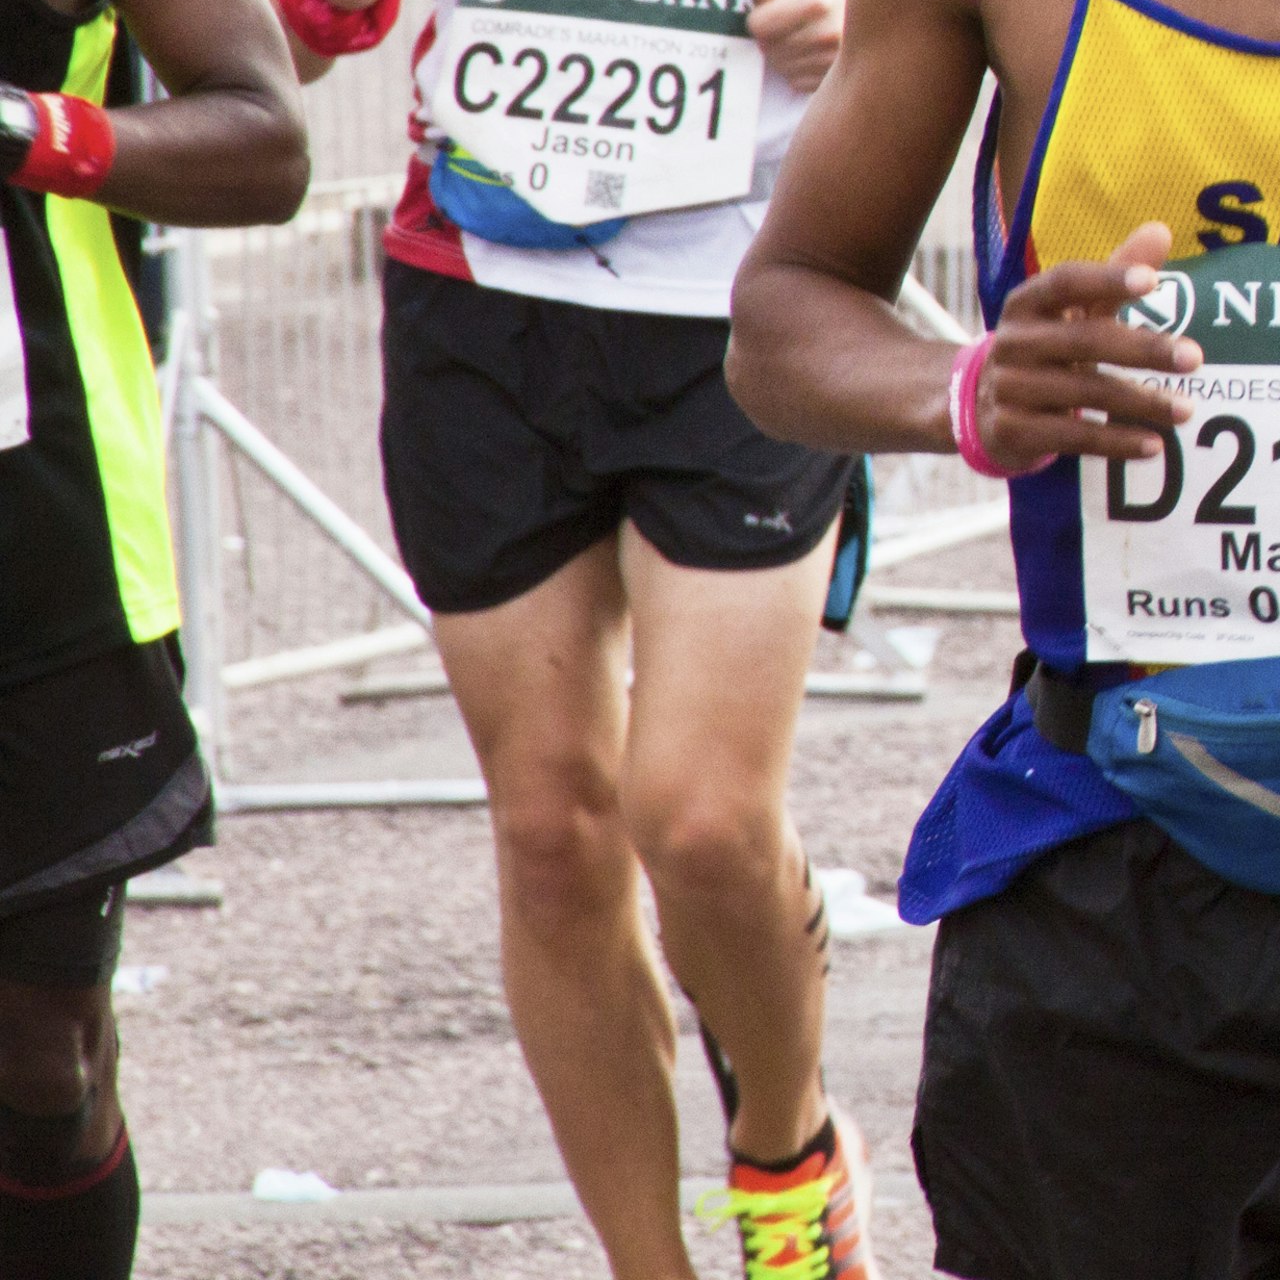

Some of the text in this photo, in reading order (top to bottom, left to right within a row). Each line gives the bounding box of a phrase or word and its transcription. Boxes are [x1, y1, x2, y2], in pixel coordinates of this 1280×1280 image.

[471, 18, 729, 60] COMRADES MARATHON 2014
[453, 42, 727, 141] C22291
[531, 127, 635, 162] Jason
[529, 162, 548, 192] 0
[1127, 584, 1280, 623] Runs 0
